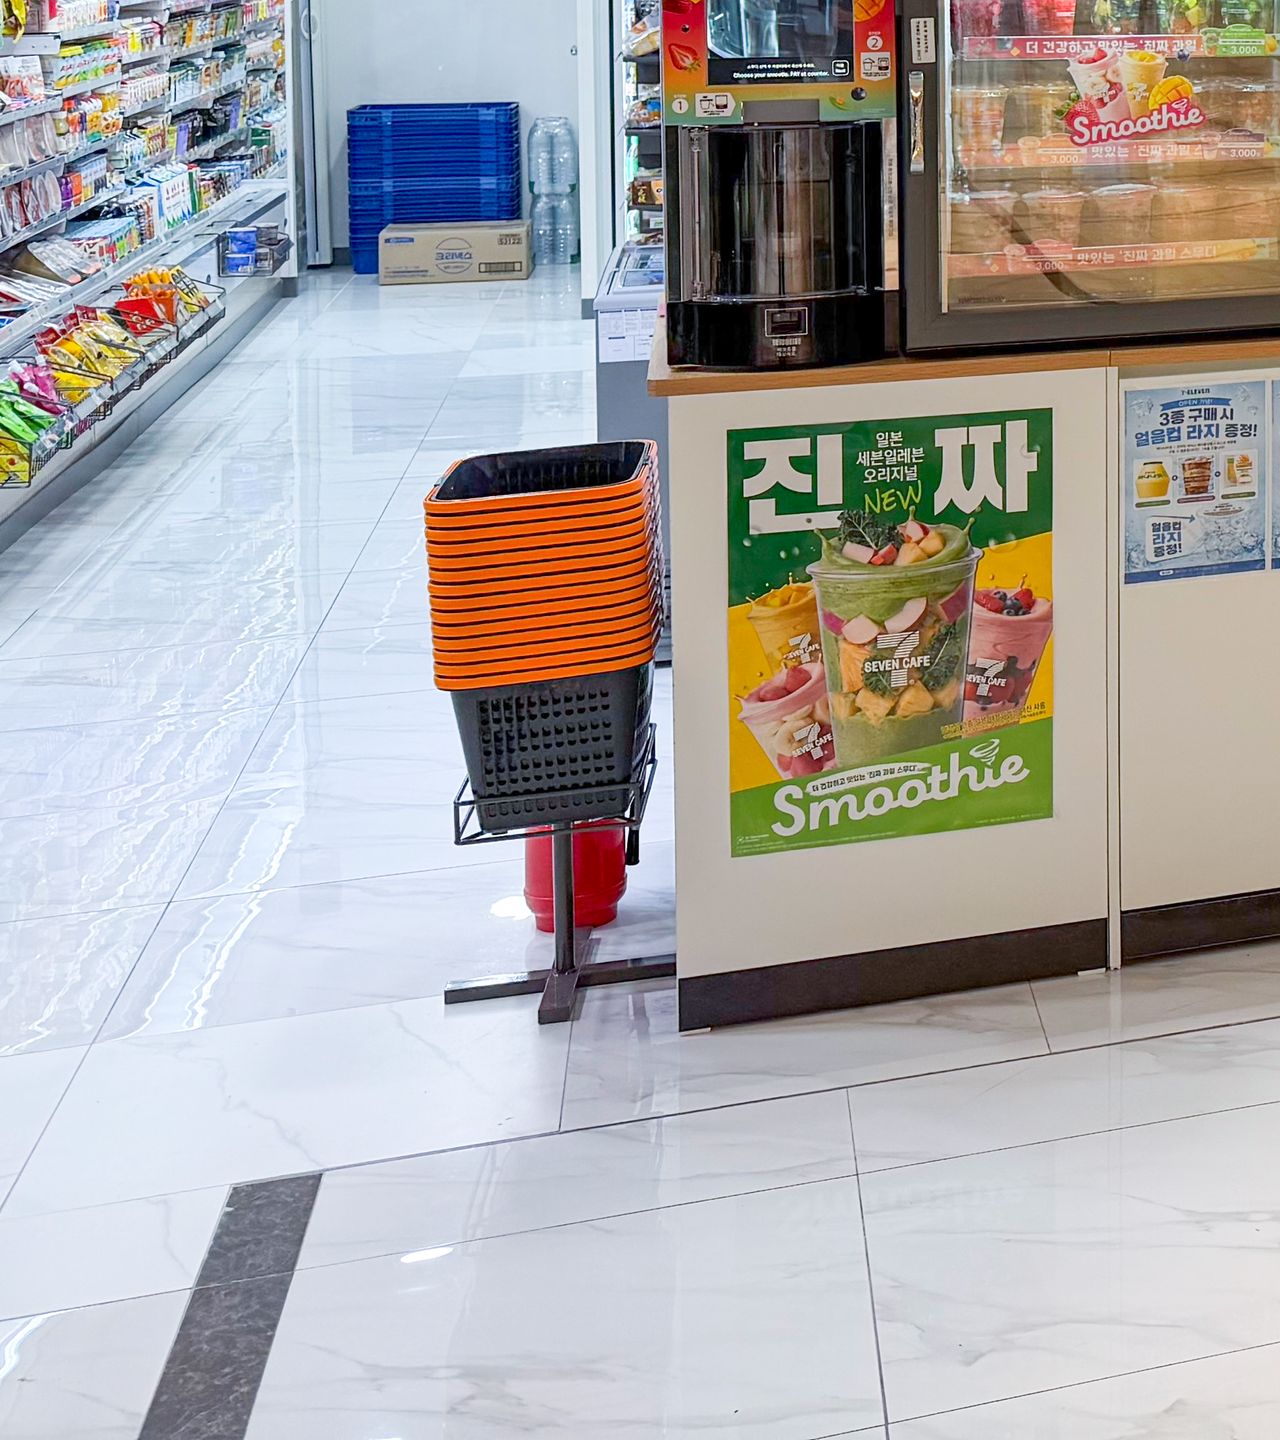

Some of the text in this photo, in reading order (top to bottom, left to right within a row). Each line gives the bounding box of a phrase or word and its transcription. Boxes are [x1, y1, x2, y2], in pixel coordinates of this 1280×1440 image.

[1026, 41, 1038, 54] 더
[1043, 40, 1096, 54] 건강하고
[1098, 39, 1137, 53] 맛있는
[1172, 39, 1197, 51] 과일
[1073, 99, 1203, 143] Smoothie
[1092, 144, 1129, 158] 맛있는
[1166, 143, 1192, 157] 과일
[1077, 250, 1115, 264] 맛있는
[1152, 247, 1177, 261] 과일
[1159, 408, 1234, 426] 3종 구매 시
[875, 431, 904, 447] 일본
[1135, 428, 1182, 447] 얼음컵
[1187, 424, 1220, 440] 라지
[1225, 424, 1257, 438] 증정!
[856, 447, 925, 467] 세븐일레븐
[863, 465, 918, 484] 오리지널
[934, 419, 1037, 516] 짜
[864, 480, 923, 514] NEW
[864, 655, 930, 672] SEVEN CAFE
[771, 742, 1030, 836] Smoothie
